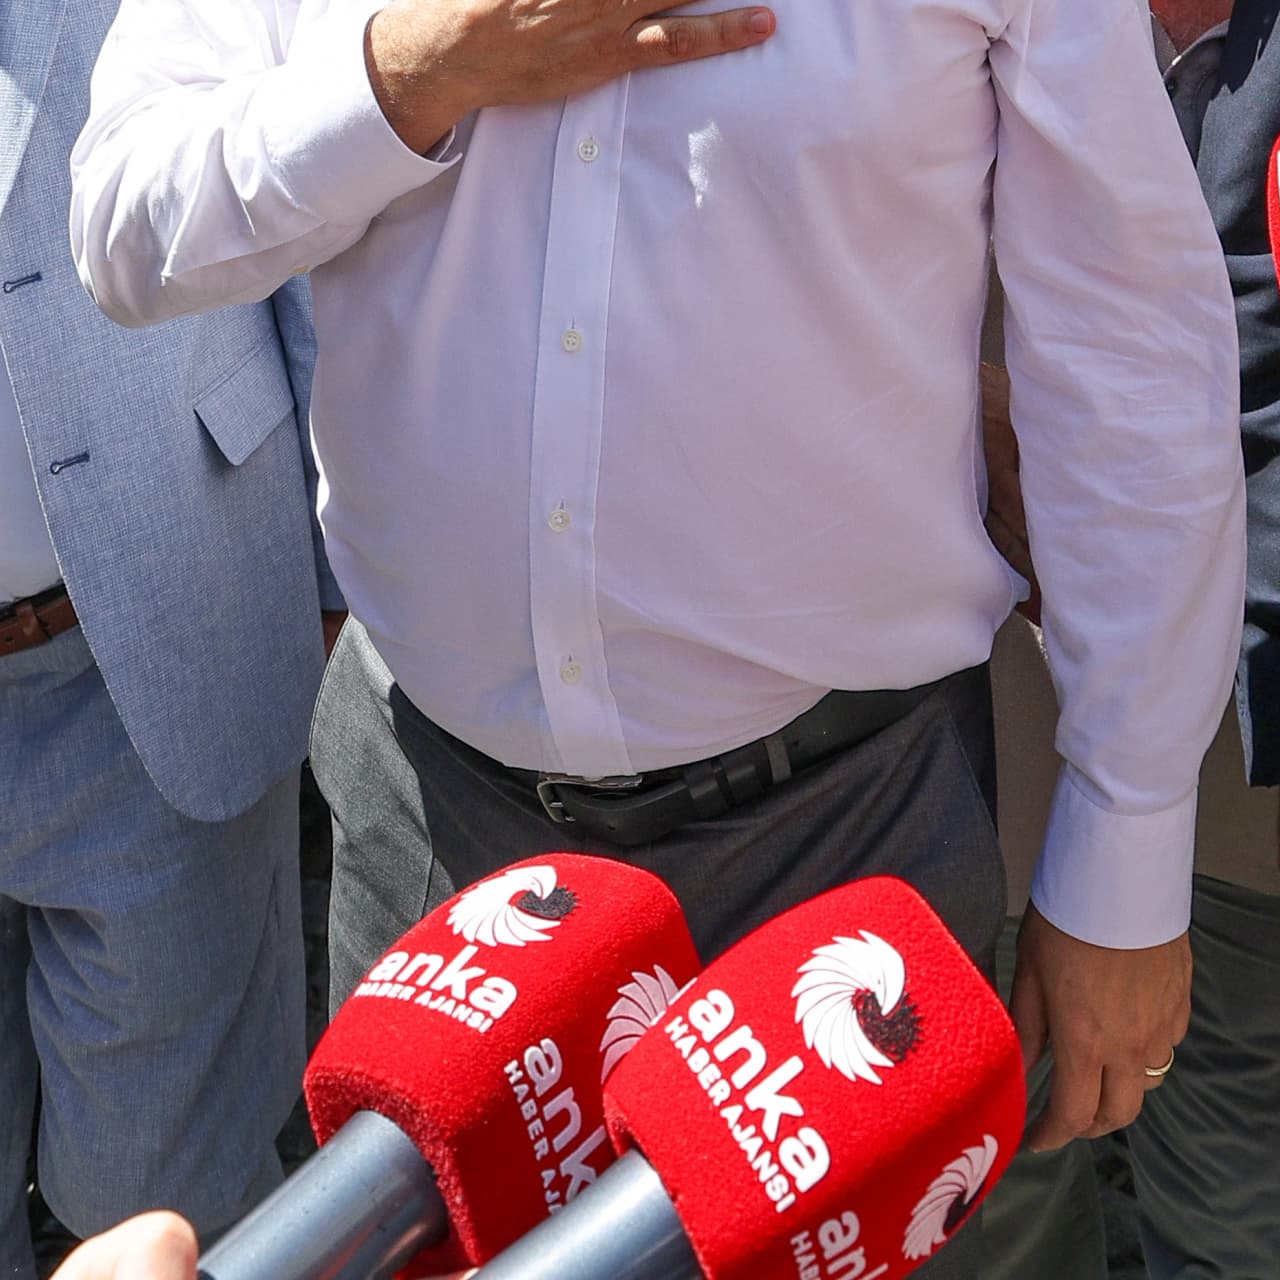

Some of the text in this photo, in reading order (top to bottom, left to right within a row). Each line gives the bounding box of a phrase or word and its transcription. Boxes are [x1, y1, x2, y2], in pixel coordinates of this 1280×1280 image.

[353, 981, 494, 1034] HABER AJANSI
[368, 944, 518, 1020] anka
[504, 1059, 550, 1162] HABER
[524, 1038, 608, 1204] ank
[665, 1016, 796, 1214] HABER AJANSI
[688, 989, 831, 1194] anka
